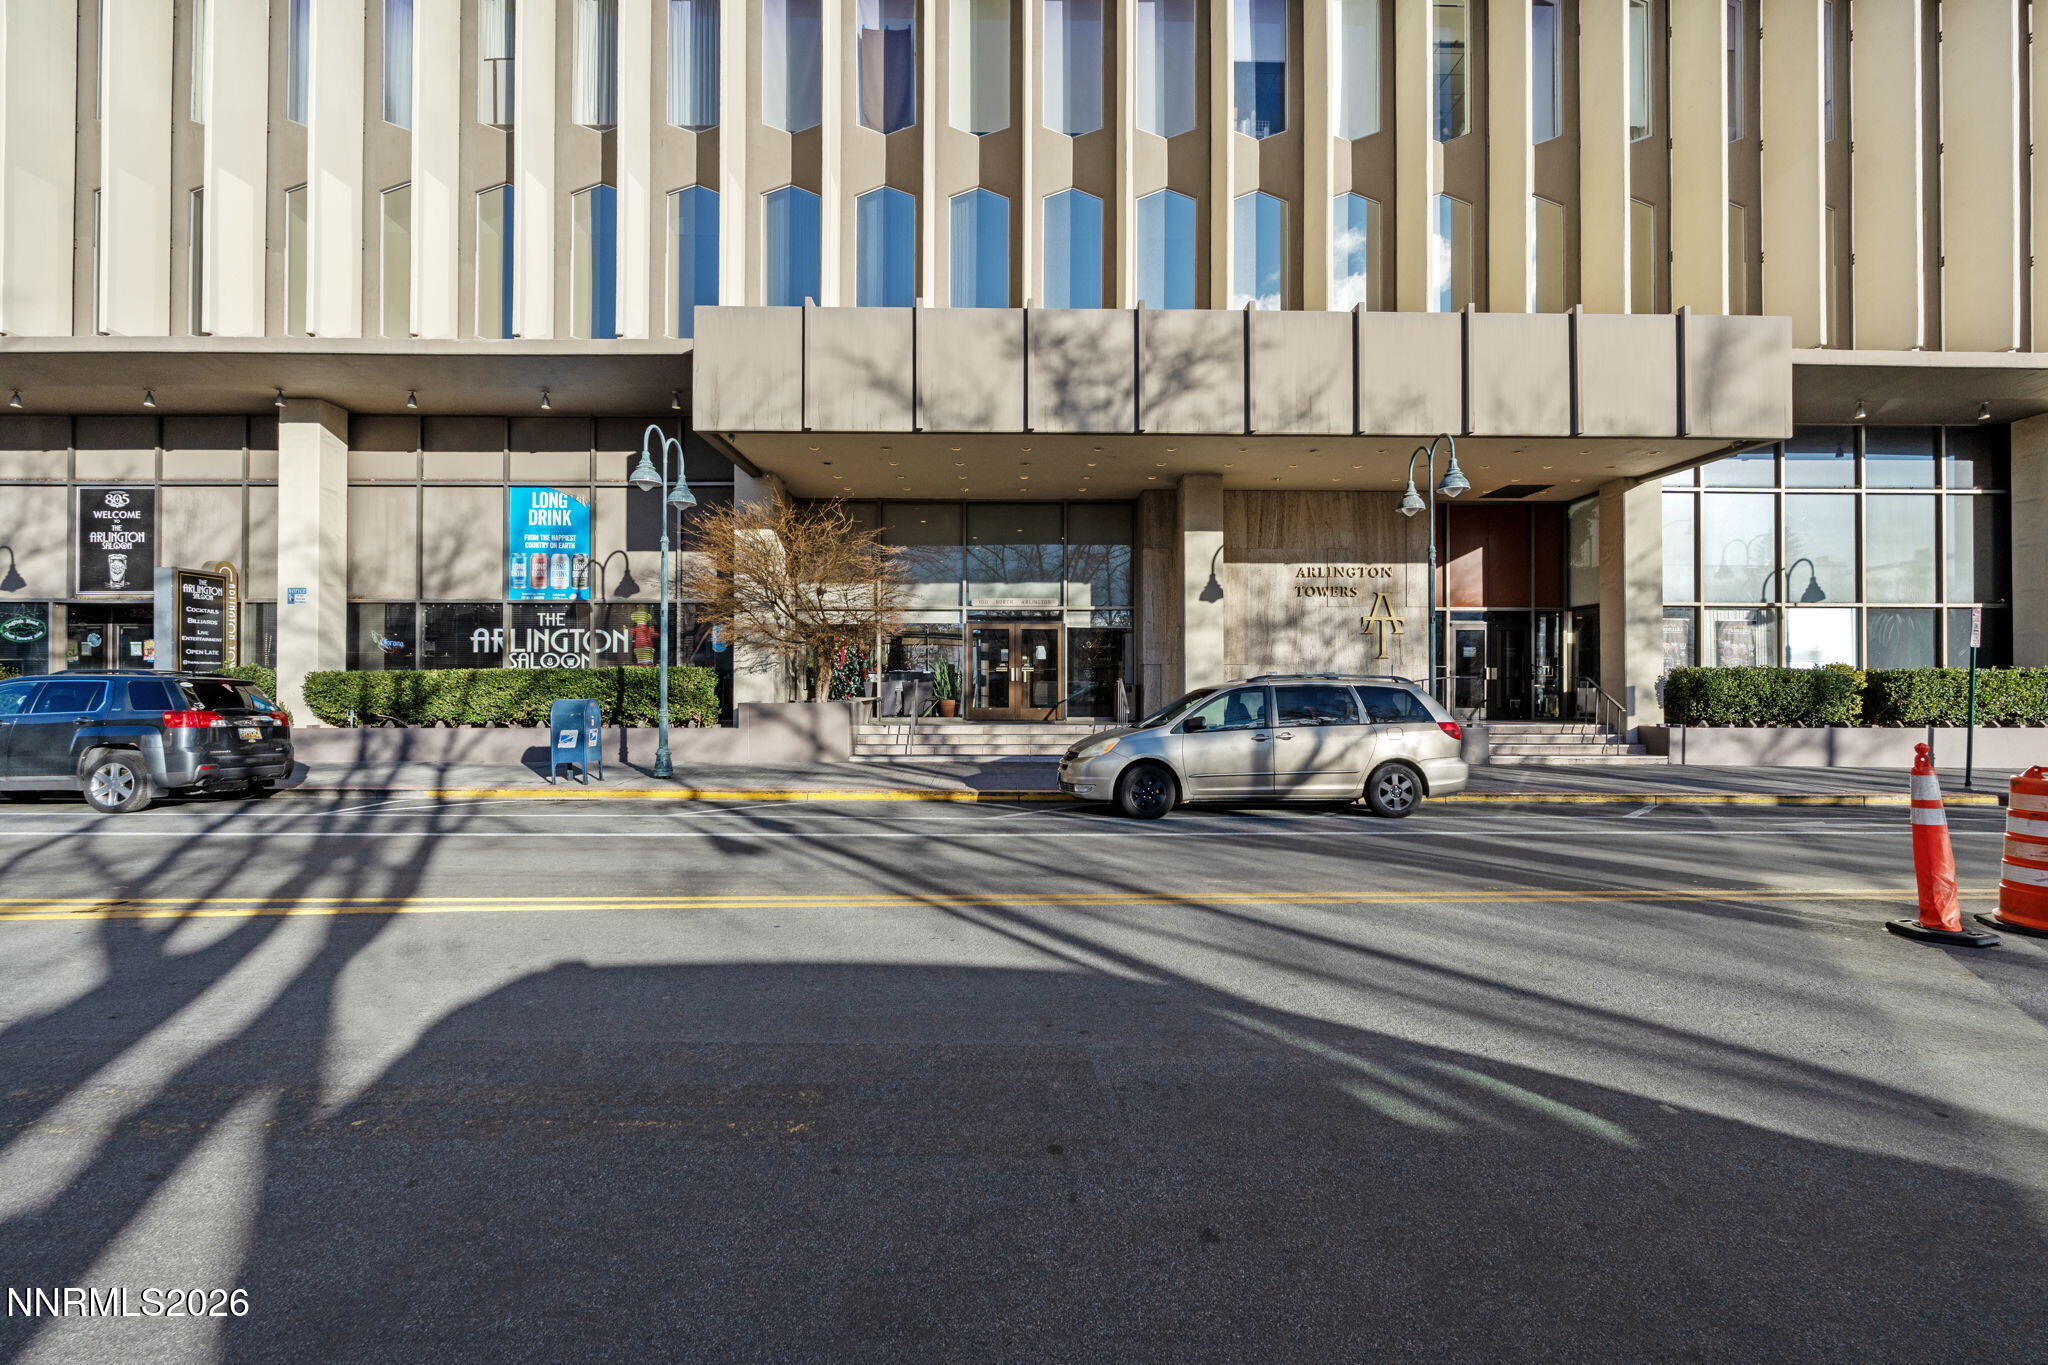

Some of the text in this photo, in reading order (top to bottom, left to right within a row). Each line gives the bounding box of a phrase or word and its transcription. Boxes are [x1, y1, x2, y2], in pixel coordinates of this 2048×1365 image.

[105, 493, 130, 506] 805
[531, 491, 568, 508] LONG
[93, 510, 142, 519] WELCOME
[528, 508, 572, 526] DRINK
[112, 524, 123, 532] THE
[89, 531, 146, 543] ARLINGTON
[552, 534, 576, 542] HAPPIEST
[101, 542, 133, 550] SALOON
[524, 541, 549, 549] COUNTRY
[558, 541, 576, 549] EARTH
[1295, 566, 1393, 579] ARLINGTON
[182, 583, 223, 597] ARLINGTON
[1294, 586, 1358, 598] TOWERS
[185, 606, 220, 615] COCKTAILS
[187, 618, 218, 626] BILLIARDS
[537, 612, 566, 627] THE
[181, 635, 222, 643] ENTERTAINMENT
[470, 628, 629, 653] ARLINGTON
[508, 652, 591, 669] SALOON
